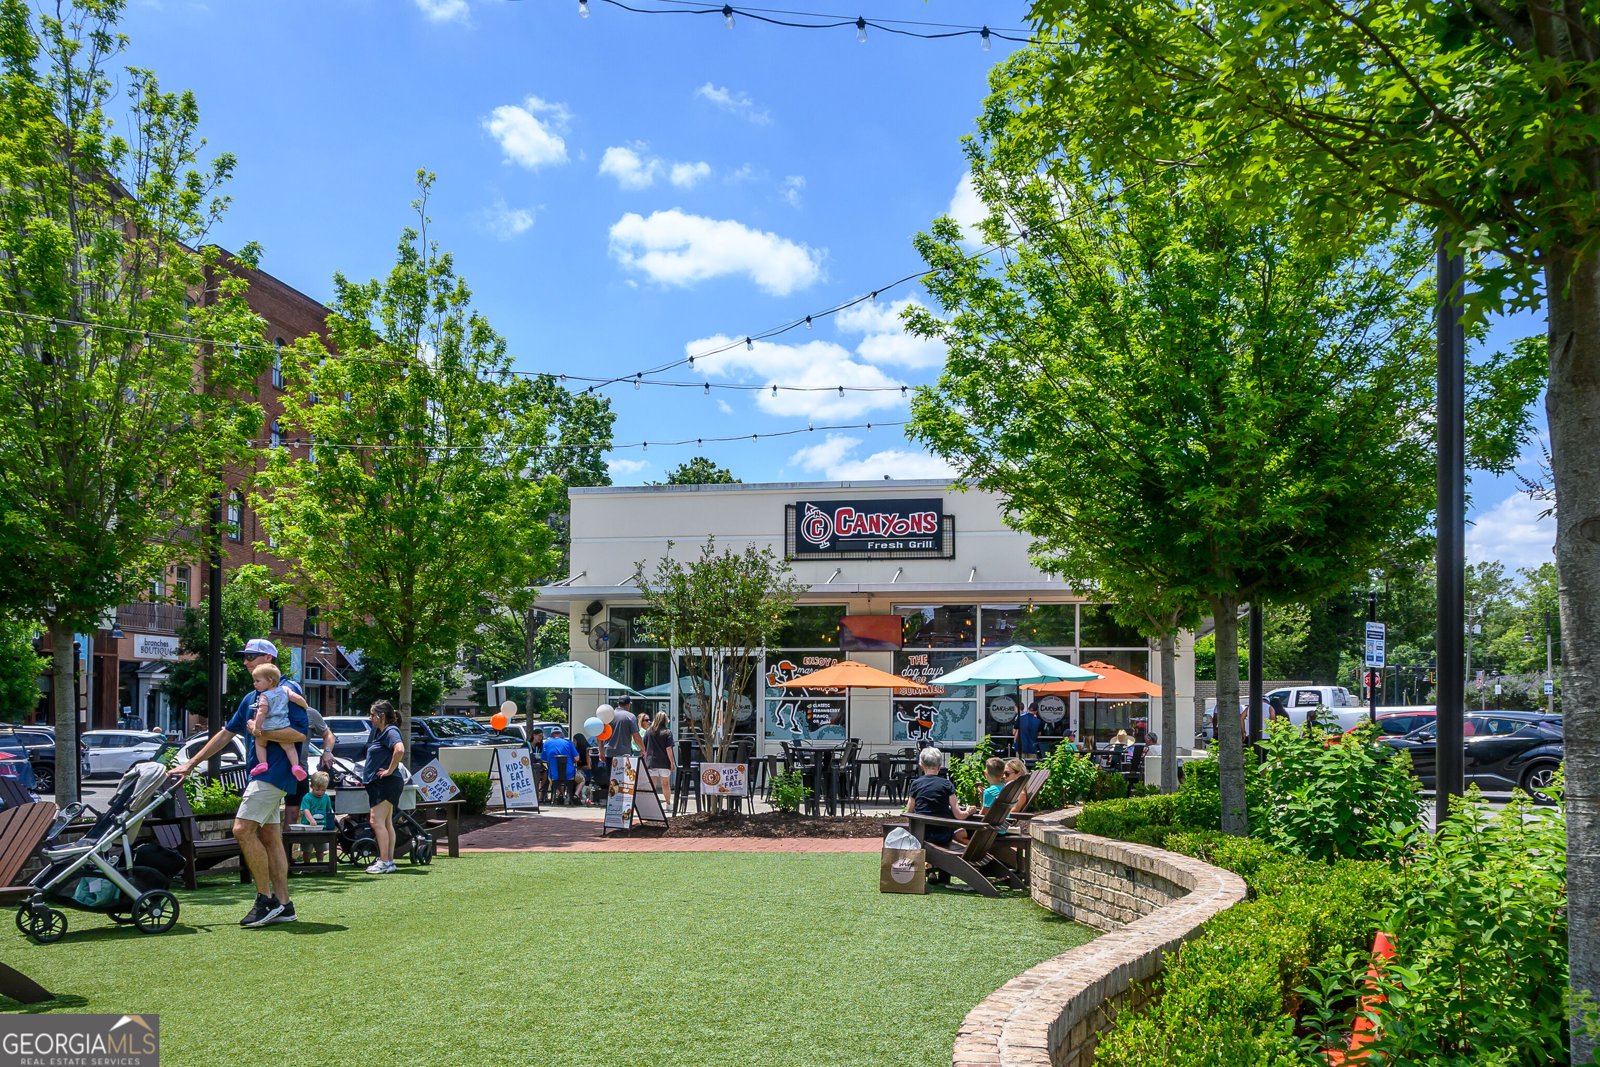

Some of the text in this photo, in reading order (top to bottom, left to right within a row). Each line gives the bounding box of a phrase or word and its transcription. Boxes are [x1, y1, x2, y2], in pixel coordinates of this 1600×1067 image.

[867, 540, 933, 550] Fresh Grill
[144, 638, 169, 647] branches
[803, 656, 831, 666] ENJOY
[907, 654, 929, 666] THE
[901, 664, 944, 680] dog days
[505, 761, 524, 772] KIDS
[510, 771, 524, 781] EAT
[434, 783, 446, 794] EAT
[437, 777, 451, 791] KIDS
[510, 778, 531, 792] FREE
[724, 780, 742, 788] FREE
[428, 787, 444, 801] FREE
